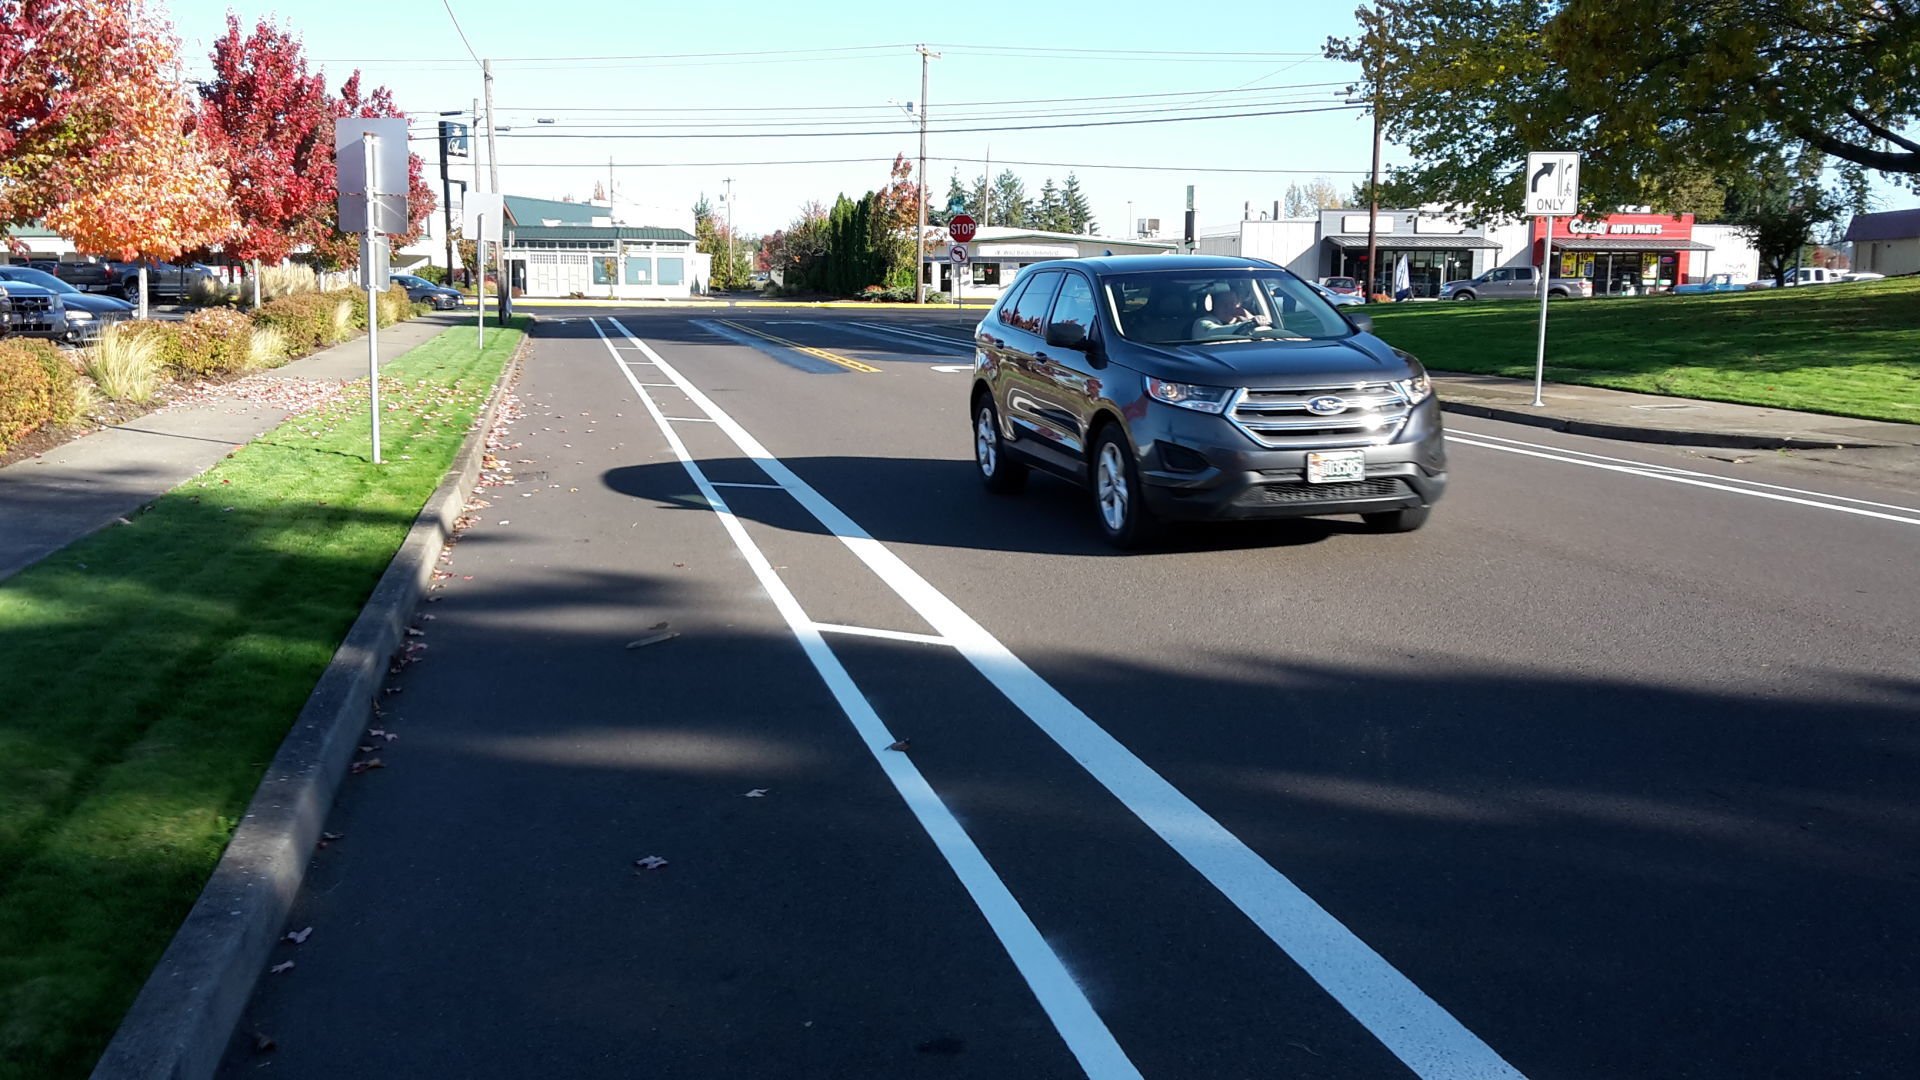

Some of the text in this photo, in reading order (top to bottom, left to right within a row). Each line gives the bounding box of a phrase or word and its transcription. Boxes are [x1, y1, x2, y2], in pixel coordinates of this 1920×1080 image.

[1537, 198, 1565, 211] ONLY
[951, 223, 975, 235] STOP
[1610, 224, 1633, 234] AUTO
[1635, 224, 1663, 234] PARTS
